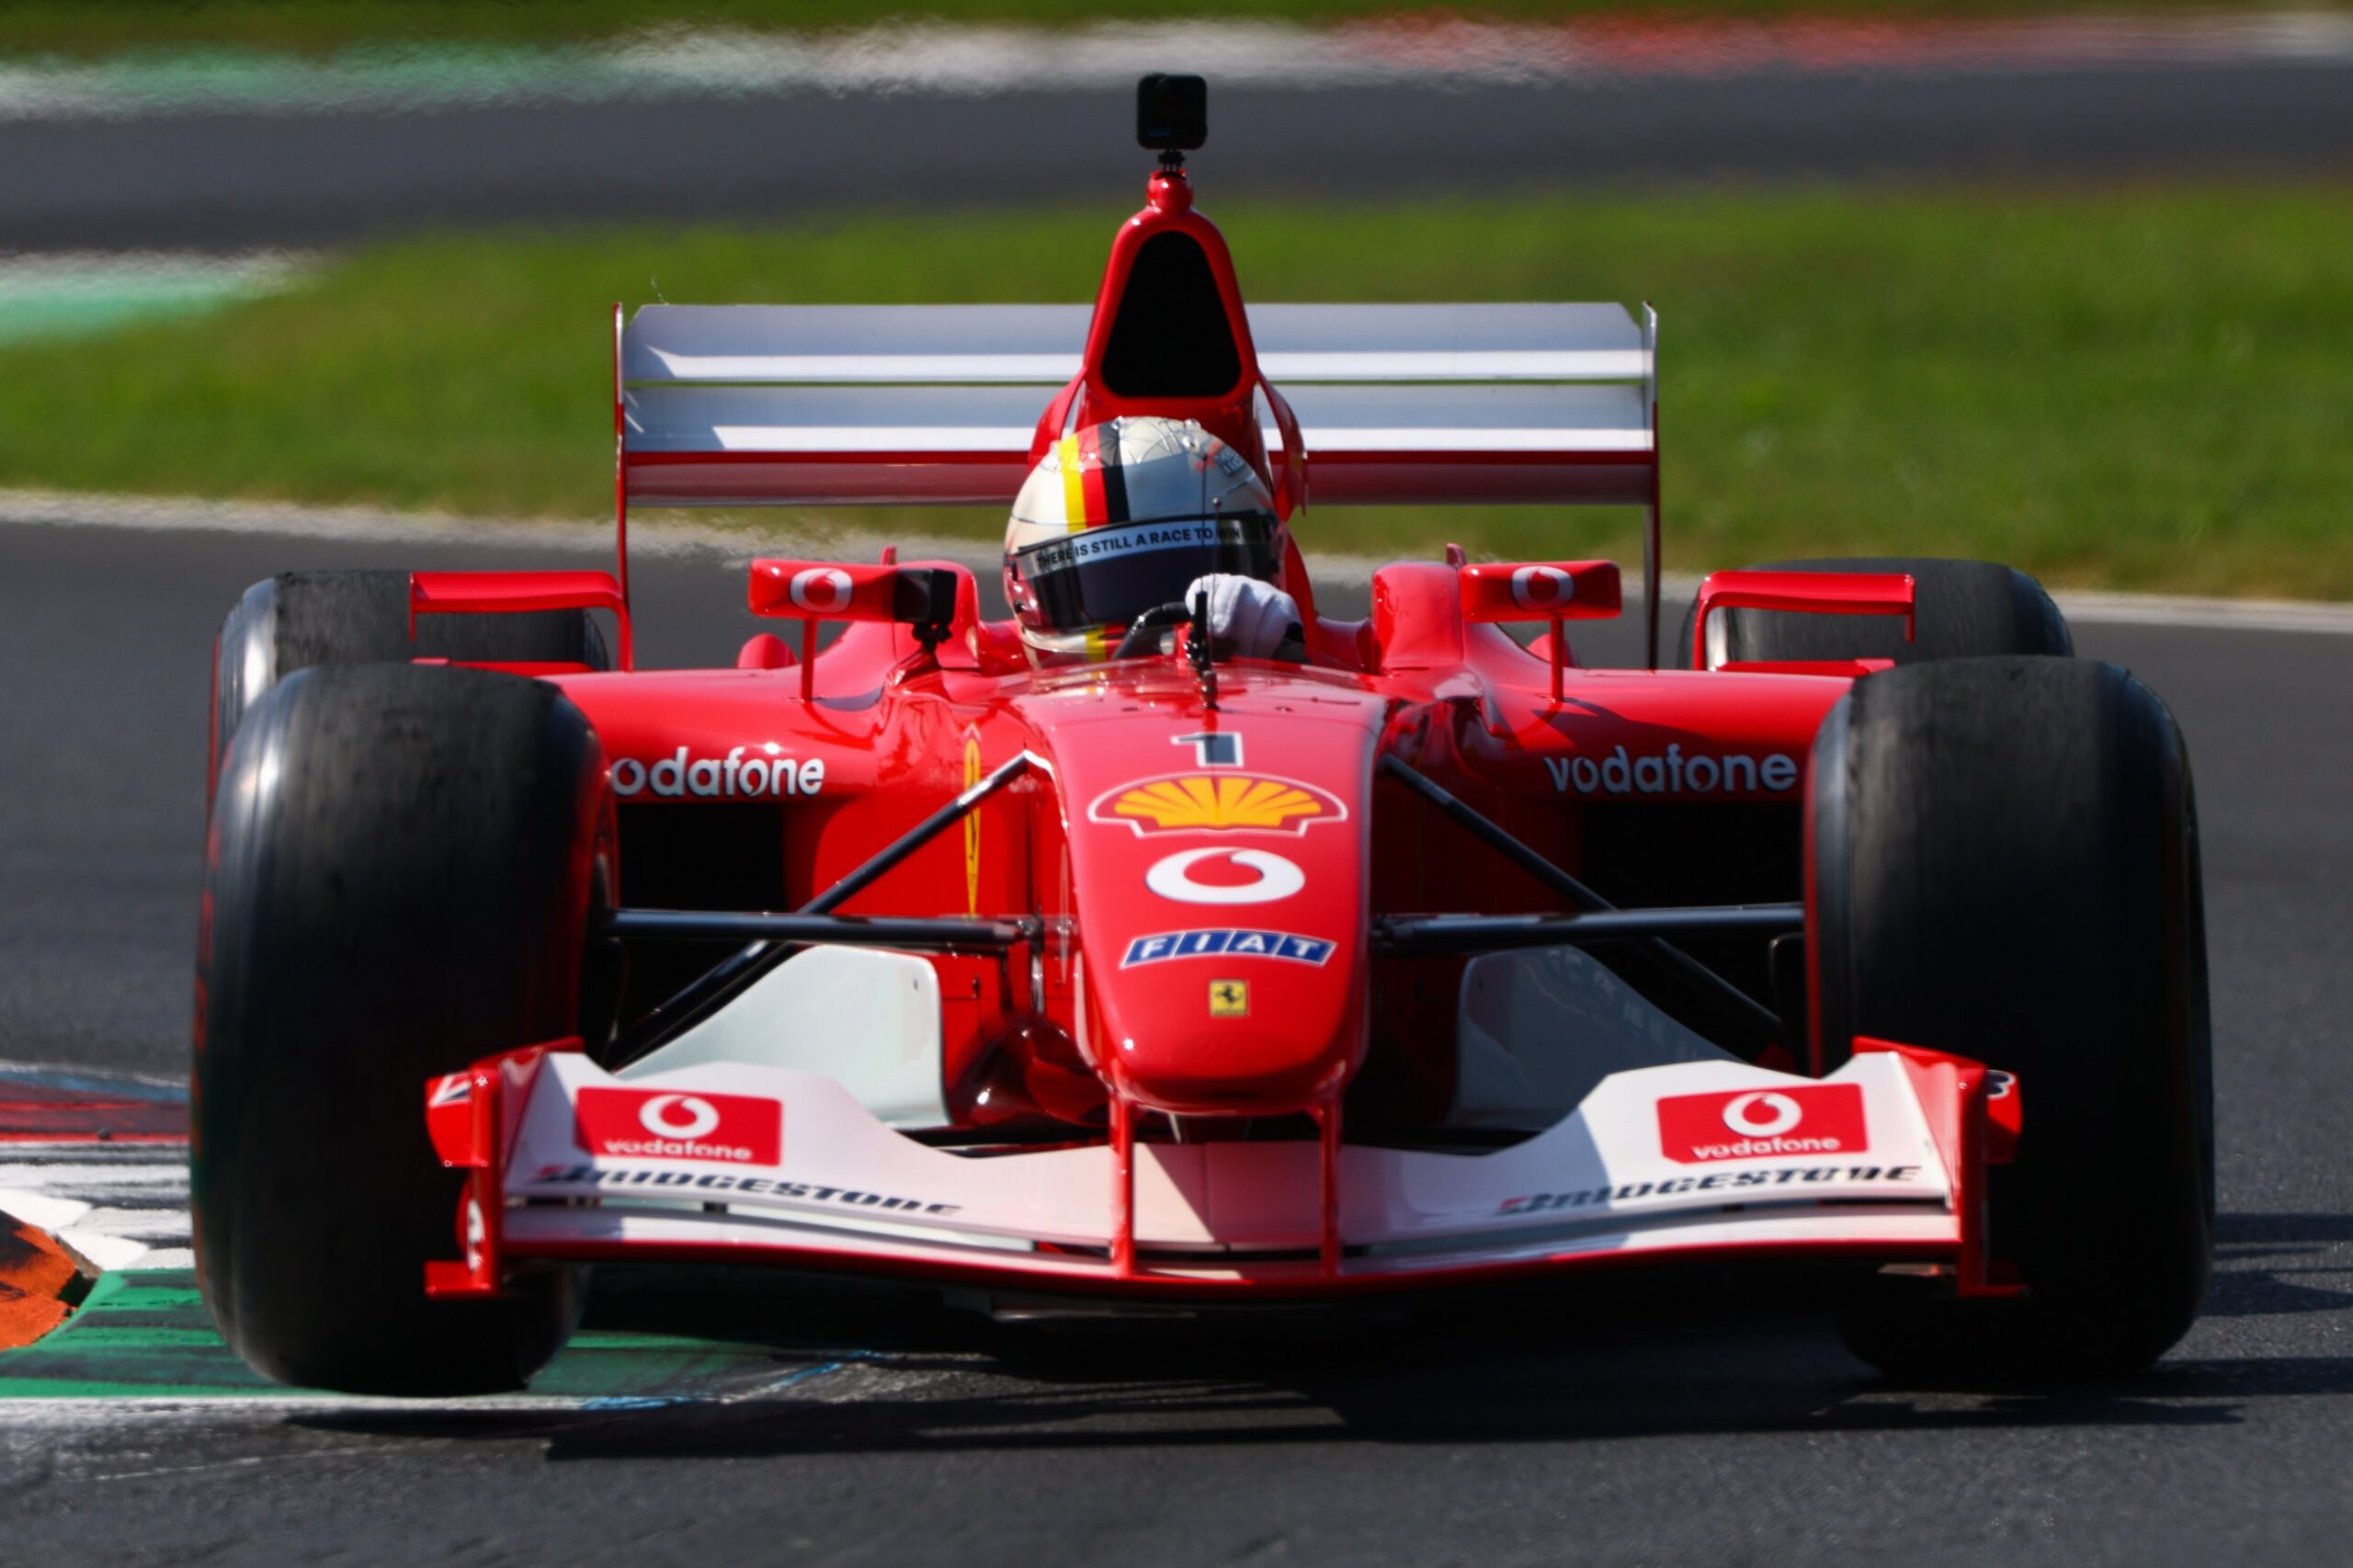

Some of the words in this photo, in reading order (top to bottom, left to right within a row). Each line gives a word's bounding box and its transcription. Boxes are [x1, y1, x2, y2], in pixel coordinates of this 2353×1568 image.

[1036, 547, 1073, 568] THERE
[1074, 543, 1089, 558] IS
[1092, 536, 1131, 554] STILL
[1135, 533, 1148, 547] A
[1149, 528, 1191, 545] RACE
[1194, 527, 1213, 540] TO
[1170, 732, 1245, 767] 1
[1543, 743, 1798, 793] vodafone
[611, 745, 825, 797] odafone
[1139, 933, 1320, 960] FIAT
[602, 1139, 754, 1161] vodafone
[1691, 1137, 1841, 1161] vodafone
[531, 1165, 962, 1216] BRIDGESTONE
[1497, 1165, 1922, 1215] BRIDGESTONE
